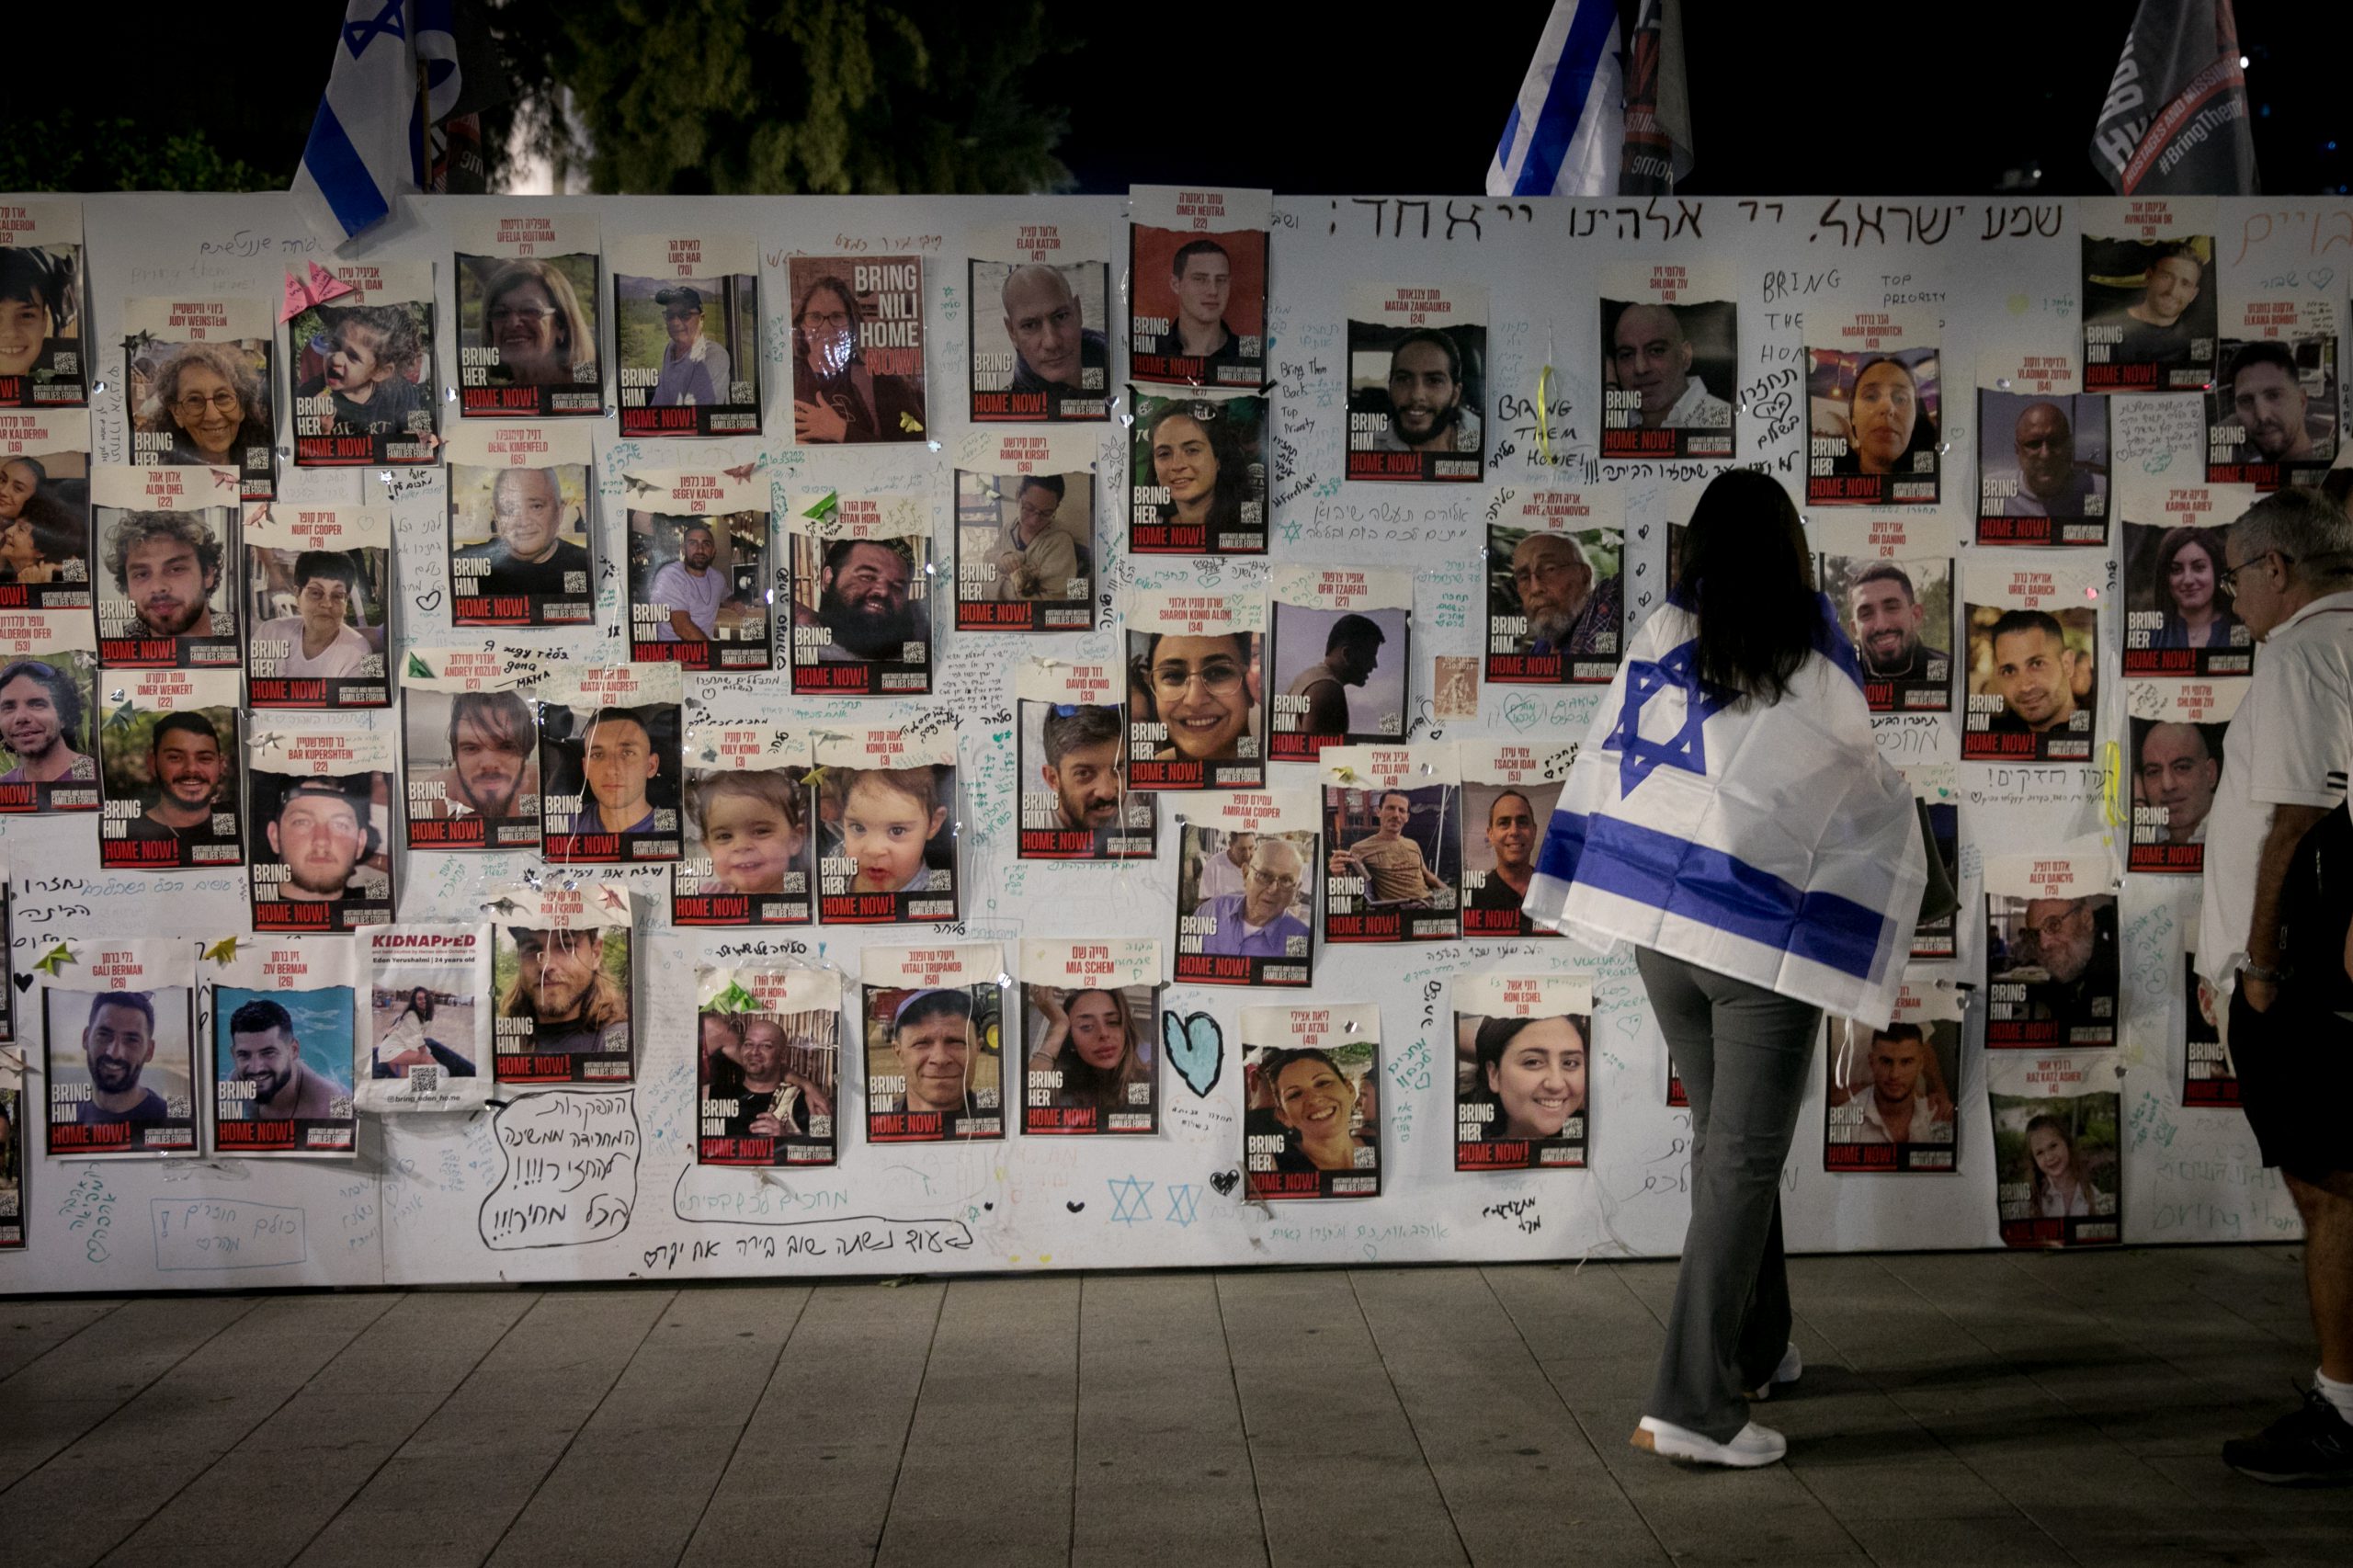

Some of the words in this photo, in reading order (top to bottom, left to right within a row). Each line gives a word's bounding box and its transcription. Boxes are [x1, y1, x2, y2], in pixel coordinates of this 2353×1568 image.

[2164, 101, 2186, 129] AND
[1176, 206, 1195, 216] OMER
[1198, 206, 1225, 217] NEUTRA
[1981, 204, 2063, 241] שמע
[496, 232, 521, 242] OFELIA
[522, 231, 555, 242] ROITMAN
[519, 243, 534, 256] (77)
[1017, 238, 1034, 249] ELAD
[1036, 238, 1061, 250] KATZIR
[1031, 250, 1046, 261] (47)
[855, 265, 917, 291] BRING
[1650, 278, 1675, 290] SHLOMI
[1677, 278, 1688, 290] ZIV
[1881, 275, 1912, 287] TOP
[1762, 268, 1840, 303] BRING
[879, 293, 917, 318] NILI
[1883, 291, 1946, 308] PRIORITY
[169, 315, 186, 327] JUDY
[187, 315, 227, 327] WEINSTEIN
[859, 322, 918, 347] HOME
[2087, 325, 2122, 343] BRING
[462, 347, 499, 366] BRING
[2087, 346, 2110, 362] HIM
[867, 348, 920, 376] NOW!
[974, 353, 1011, 370] BRING
[463, 368, 487, 385] HER
[1280, 361, 1305, 381] Bring
[974, 372, 997, 391] HIM
[1282, 381, 1307, 399] Back
[465, 388, 501, 407] HOME
[503, 386, 539, 406] NOW!
[974, 394, 1009, 413] HOME
[1012, 392, 1047, 412] NOW!
[552, 399, 577, 409] FAMILIES
[578, 398, 598, 408] FORUM
[1000, 449, 1023, 460] RIMON
[1025, 449, 1050, 460] KIRSHT
[1017, 460, 1032, 472] (36)
[145, 484, 165, 495] ALON
[166, 484, 184, 495] OHEL
[673, 488, 694, 499] SEGEV
[696, 488, 723, 499] KALFON
[690, 500, 706, 512] (25)
[1522, 505, 1540, 515] ARYE
[1549, 517, 1563, 529] (85)
[291, 524, 313, 535] NURIT
[314, 524, 342, 536] COOPER
[1869, 534, 1880, 545] ORI
[1881, 534, 1906, 546] DANINO
[99, 600, 137, 619] BRING
[2129, 611, 2164, 629] BRING
[100, 620, 124, 638] HIM
[2128, 631, 2150, 648] HER
[102, 642, 137, 660] HOME
[141, 638, 176, 659] NOW!
[483, 640, 495, 653] Я
[444, 665, 472, 677] ANDREY
[473, 665, 501, 677] KOZLOV
[1965, 735, 1999, 753] HOME
[2002, 733, 2037, 752] NOW!
[721, 744, 738, 755] YULY
[739, 744, 760, 755] KONIO
[735, 756, 745, 767] (3)
[1494, 758, 1518, 769] TSACHI
[1520, 758, 1536, 770] IDAN
[1222, 806, 1251, 817] AMIRAM
[1253, 806, 1280, 818] COOPER
[1244, 818, 1258, 830] (84)
[2029, 872, 2047, 883] ALEX
[372, 935, 476, 947] KIDNAPPED
[1072, 947, 1086, 959] שם
[92, 964, 109, 975] GALI
[111, 964, 142, 975] BERMAN
[263, 963, 276, 975] ZIV
[278, 963, 307, 974] BERMAN
[902, 963, 923, 974] VITALI
[925, 961, 961, 973] TRUPANOB
[1066, 961, 1083, 973] MIA
[1085, 961, 1115, 973] SCHEM
[924, 973, 939, 986] (50)
[1084, 974, 1097, 986] (21)
[1504, 992, 1519, 1003] RONI
[1520, 992, 1541, 1004] ESHEL
[1517, 1004, 1529, 1015] (19)
[1291, 1023, 1307, 1033] LIAT
[1309, 1022, 1328, 1033] ATZILI
[51, 1083, 91, 1102] BRING
[52, 1103, 77, 1122] HIM
[52, 1124, 89, 1144] HOME
[92, 1122, 131, 1143] NOW!
[145, 1135, 169, 1144] FAMILIES
[171, 1134, 192, 1144] FORUM
